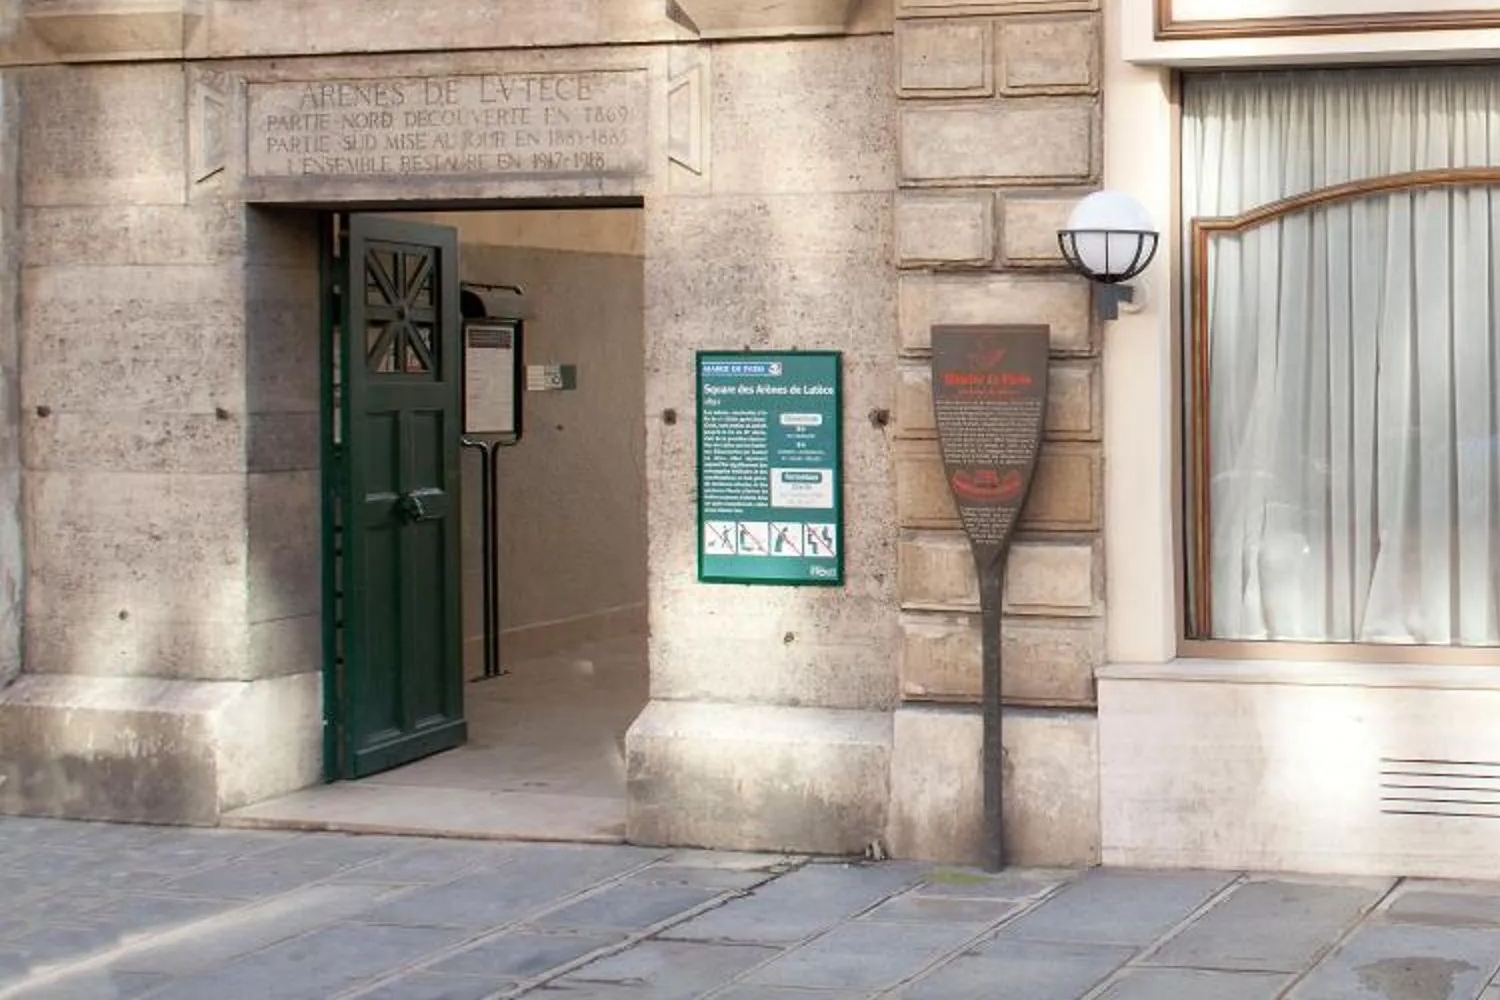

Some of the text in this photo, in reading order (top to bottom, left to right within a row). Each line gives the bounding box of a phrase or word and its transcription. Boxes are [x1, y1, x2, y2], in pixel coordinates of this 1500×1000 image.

[425, 79, 459, 106] DE
[267, 113, 330, 133] PARTIE
[342, 110, 393, 130] NORD
[342, 134, 378, 152] SUD
